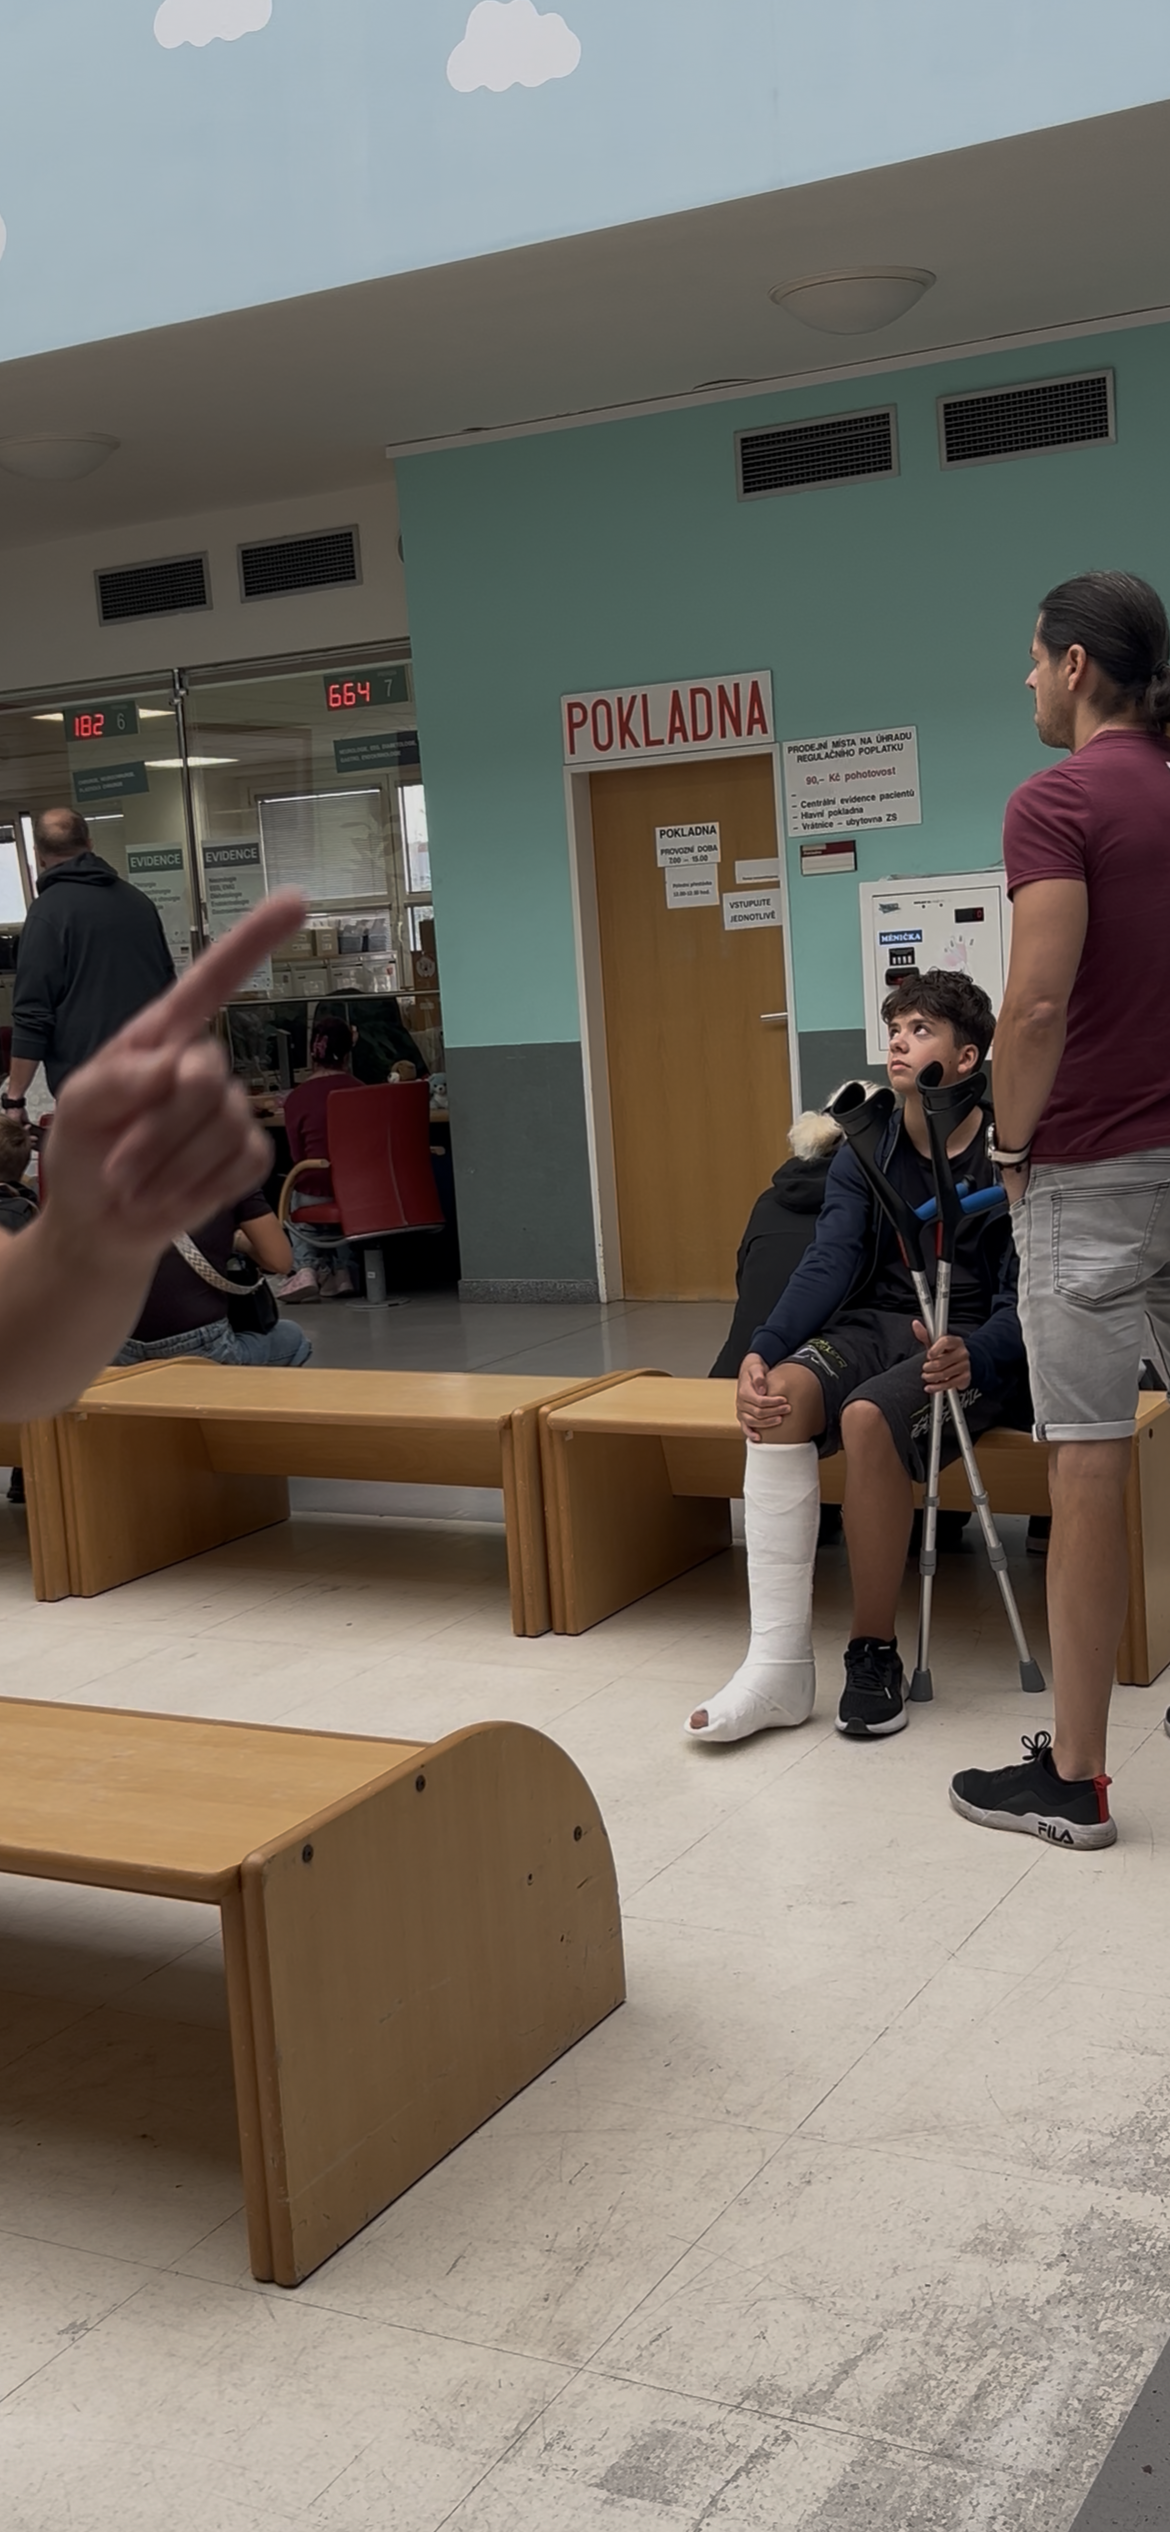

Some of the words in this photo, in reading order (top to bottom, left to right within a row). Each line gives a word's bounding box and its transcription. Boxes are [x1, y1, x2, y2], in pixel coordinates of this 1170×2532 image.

[329, 681, 370, 707] 664
[384, 679, 393, 697] 7
[74, 713, 104, 736] 182
[117, 713, 125, 730] 6
[567, 680, 768, 755] POKLADNA
[787, 741, 828, 754] PRODEJNÍ
[832, 737, 857, 749] MÍSTA
[860, 737, 872, 745] NA
[876, 731, 912, 744] ÚHRADU
[797, 748, 855, 763] REGULAČNÍHO
[858, 743, 904, 756] POPLATKU
[828, 772, 841, 782] Kč
[844, 767, 896, 782] pohotovost
[800, 797, 836, 809] Centrální
[840, 794, 876, 805] evidence
[879, 789, 915, 802] pacientů
[801, 809, 825, 820] Hlavní
[828, 806, 864, 818] pokladna
[802, 820, 834, 831] Vrátnice
[846, 815, 883, 827] ubytovna
[659, 825, 717, 839] POKLADNA
[205, 847, 257, 863] EVIDENCE
[660, 844, 695, 856] PROVOZNÍ
[697, 844, 718, 853] DOBA
[130, 853, 181, 868] EVIDENCE
[729, 898, 771, 909] VSTUPUJTE
[730, 910, 776, 923] JEDNOTLIVĚ
[881, 931, 921, 943] MĚNIČKA
[1037, 1821, 1074, 1845] FILA
